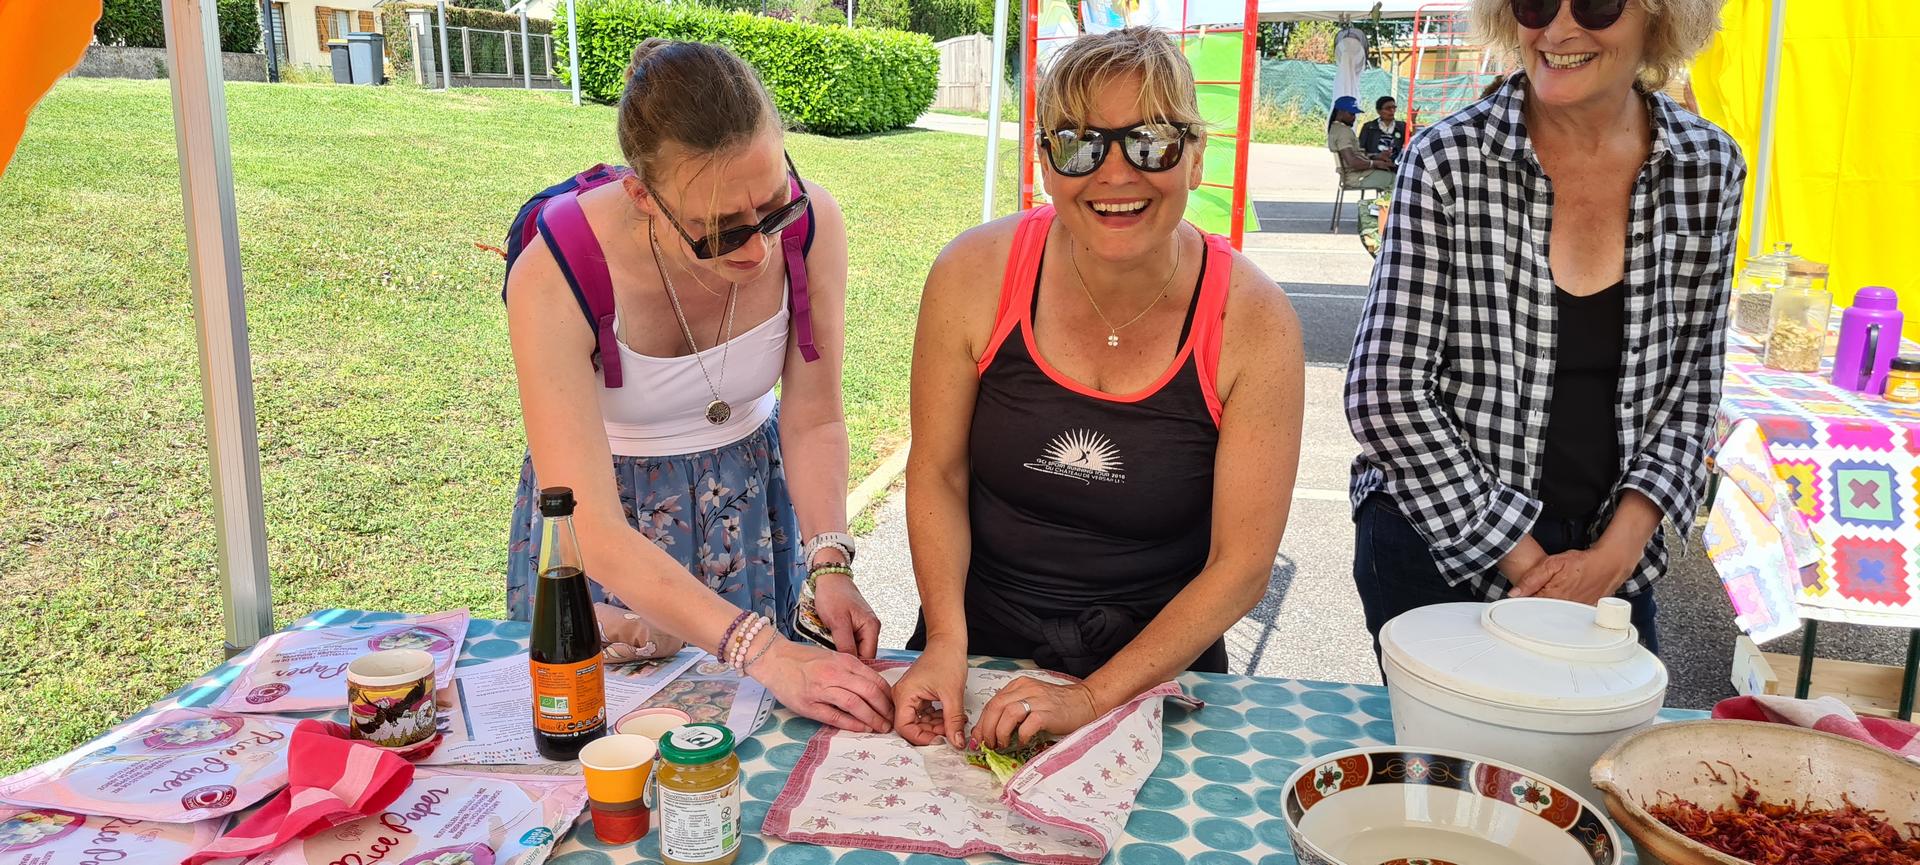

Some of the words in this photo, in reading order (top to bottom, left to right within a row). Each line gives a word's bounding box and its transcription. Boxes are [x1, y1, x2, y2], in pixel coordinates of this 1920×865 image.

[272, 661, 349, 679] Paper
[149, 756, 231, 794] Paper
[380, 787, 449, 834] Paper
